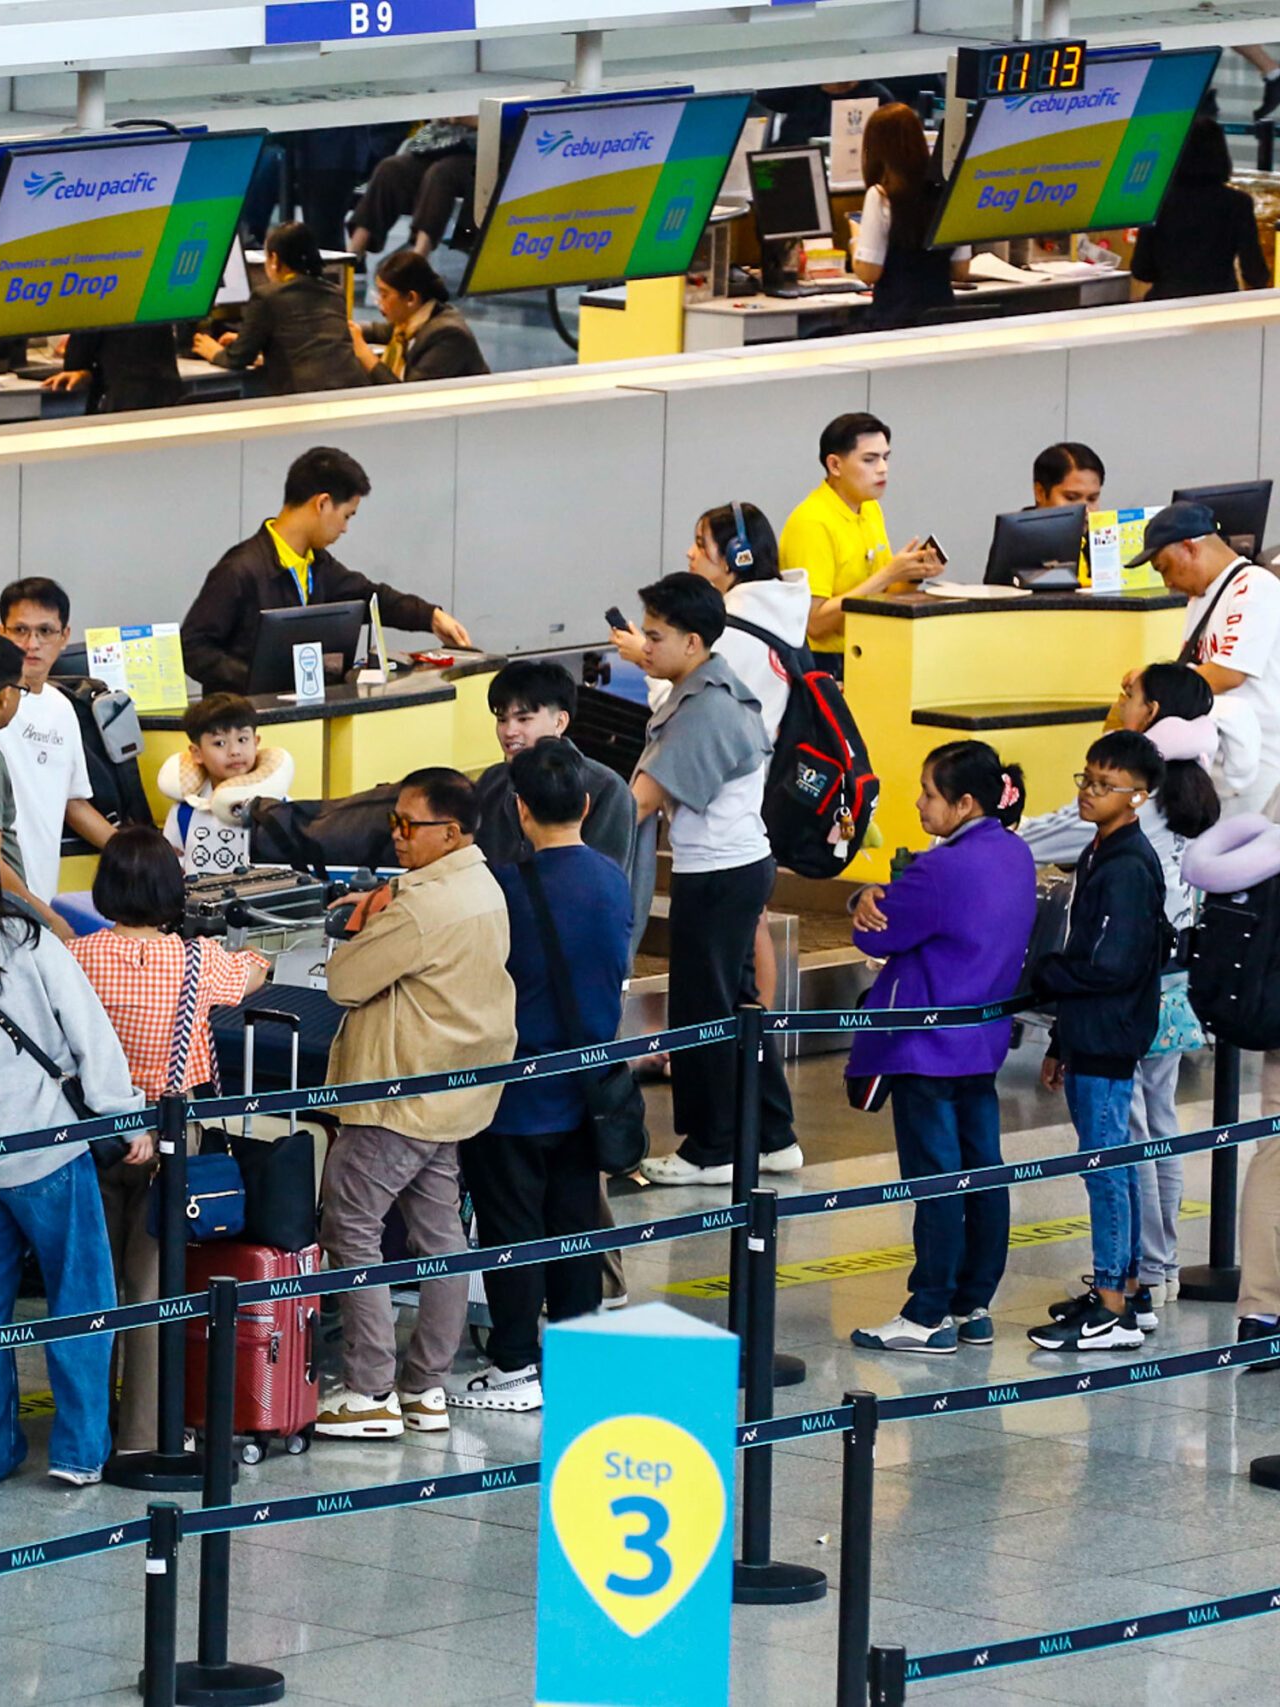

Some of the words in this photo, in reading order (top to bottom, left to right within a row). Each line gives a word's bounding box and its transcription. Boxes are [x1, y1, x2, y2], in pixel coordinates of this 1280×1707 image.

[350, 2, 369, 35] B
[376, 0, 393, 33] 9
[1030, 94, 1065, 114] cebu
[1066, 87, 1120, 115] pacific
[562, 137, 598, 158] cebu
[600, 130, 654, 159] pacific
[55, 179, 95, 200] cebu
[97, 171, 158, 201] pacific
[977, 185, 1019, 212] Bag
[1024, 180, 1077, 207] Drop
[511, 232, 553, 260] Bag
[558, 227, 613, 255] Drop
[5, 277, 52, 307] Bag
[59, 272, 118, 300] Drop
[839, 1014, 872, 1028] NAIA
[699, 1025, 724, 1040] NAIA
[580, 1048, 608, 1064] NAIA
[448, 1072, 477, 1087] NAIA
[308, 1090, 338, 1105] NAIA
[114, 1115, 144, 1130] NAIA
[1144, 1143, 1173, 1157] NAIA
[1014, 1164, 1043, 1180] NAIA
[883, 1186, 912, 1200] NAIA
[702, 1212, 733, 1228] NAIA
[560, 1237, 591, 1253] NAIA
[417, 1259, 447, 1274] NAIA
[270, 1281, 302, 1296] NAIA
[159, 1300, 193, 1316] NAIA
[0, 1327, 34, 1343] NAIA
[1129, 1364, 1160, 1379] NAIA
[988, 1387, 1020, 1402] NAIA
[802, 1414, 836, 1431] NAIA
[604, 1452, 673, 1488] Step
[481, 1470, 516, 1487] NAIA
[317, 1495, 352, 1511] NAIA
[605, 1495, 673, 1597] 3
[11, 1546, 45, 1565] NAIA
[1187, 1606, 1220, 1624] NAIA
[1040, 1635, 1072, 1654] NAIA
